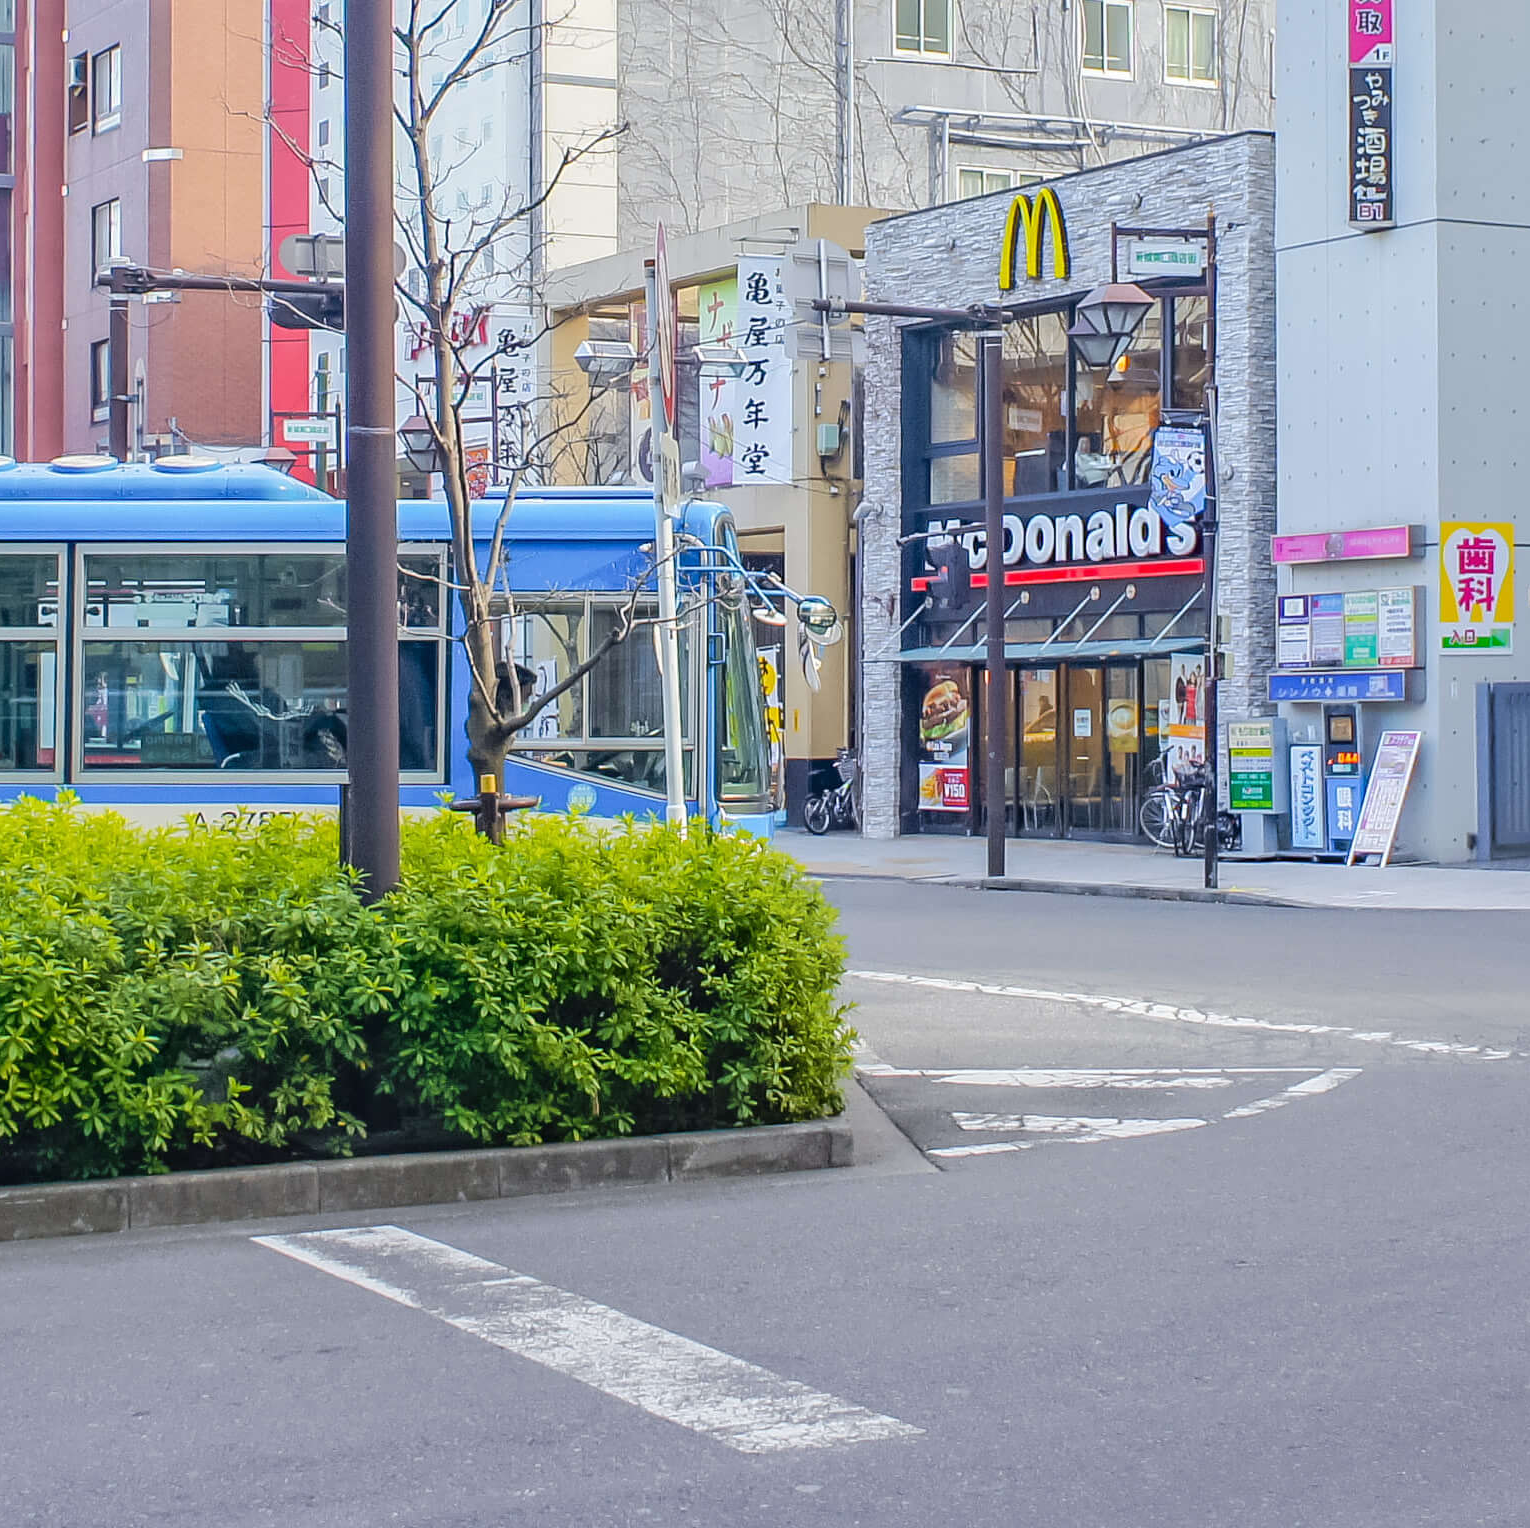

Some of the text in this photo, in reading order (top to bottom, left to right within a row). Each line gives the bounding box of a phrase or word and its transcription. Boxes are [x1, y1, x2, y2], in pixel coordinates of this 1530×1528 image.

[1372, 48, 1389, 62] 1F
[741, 272, 773, 476] 亀屋万年堂
[1456, 536, 1498, 612] 歯科
[1450, 628, 1477, 646] 入口
